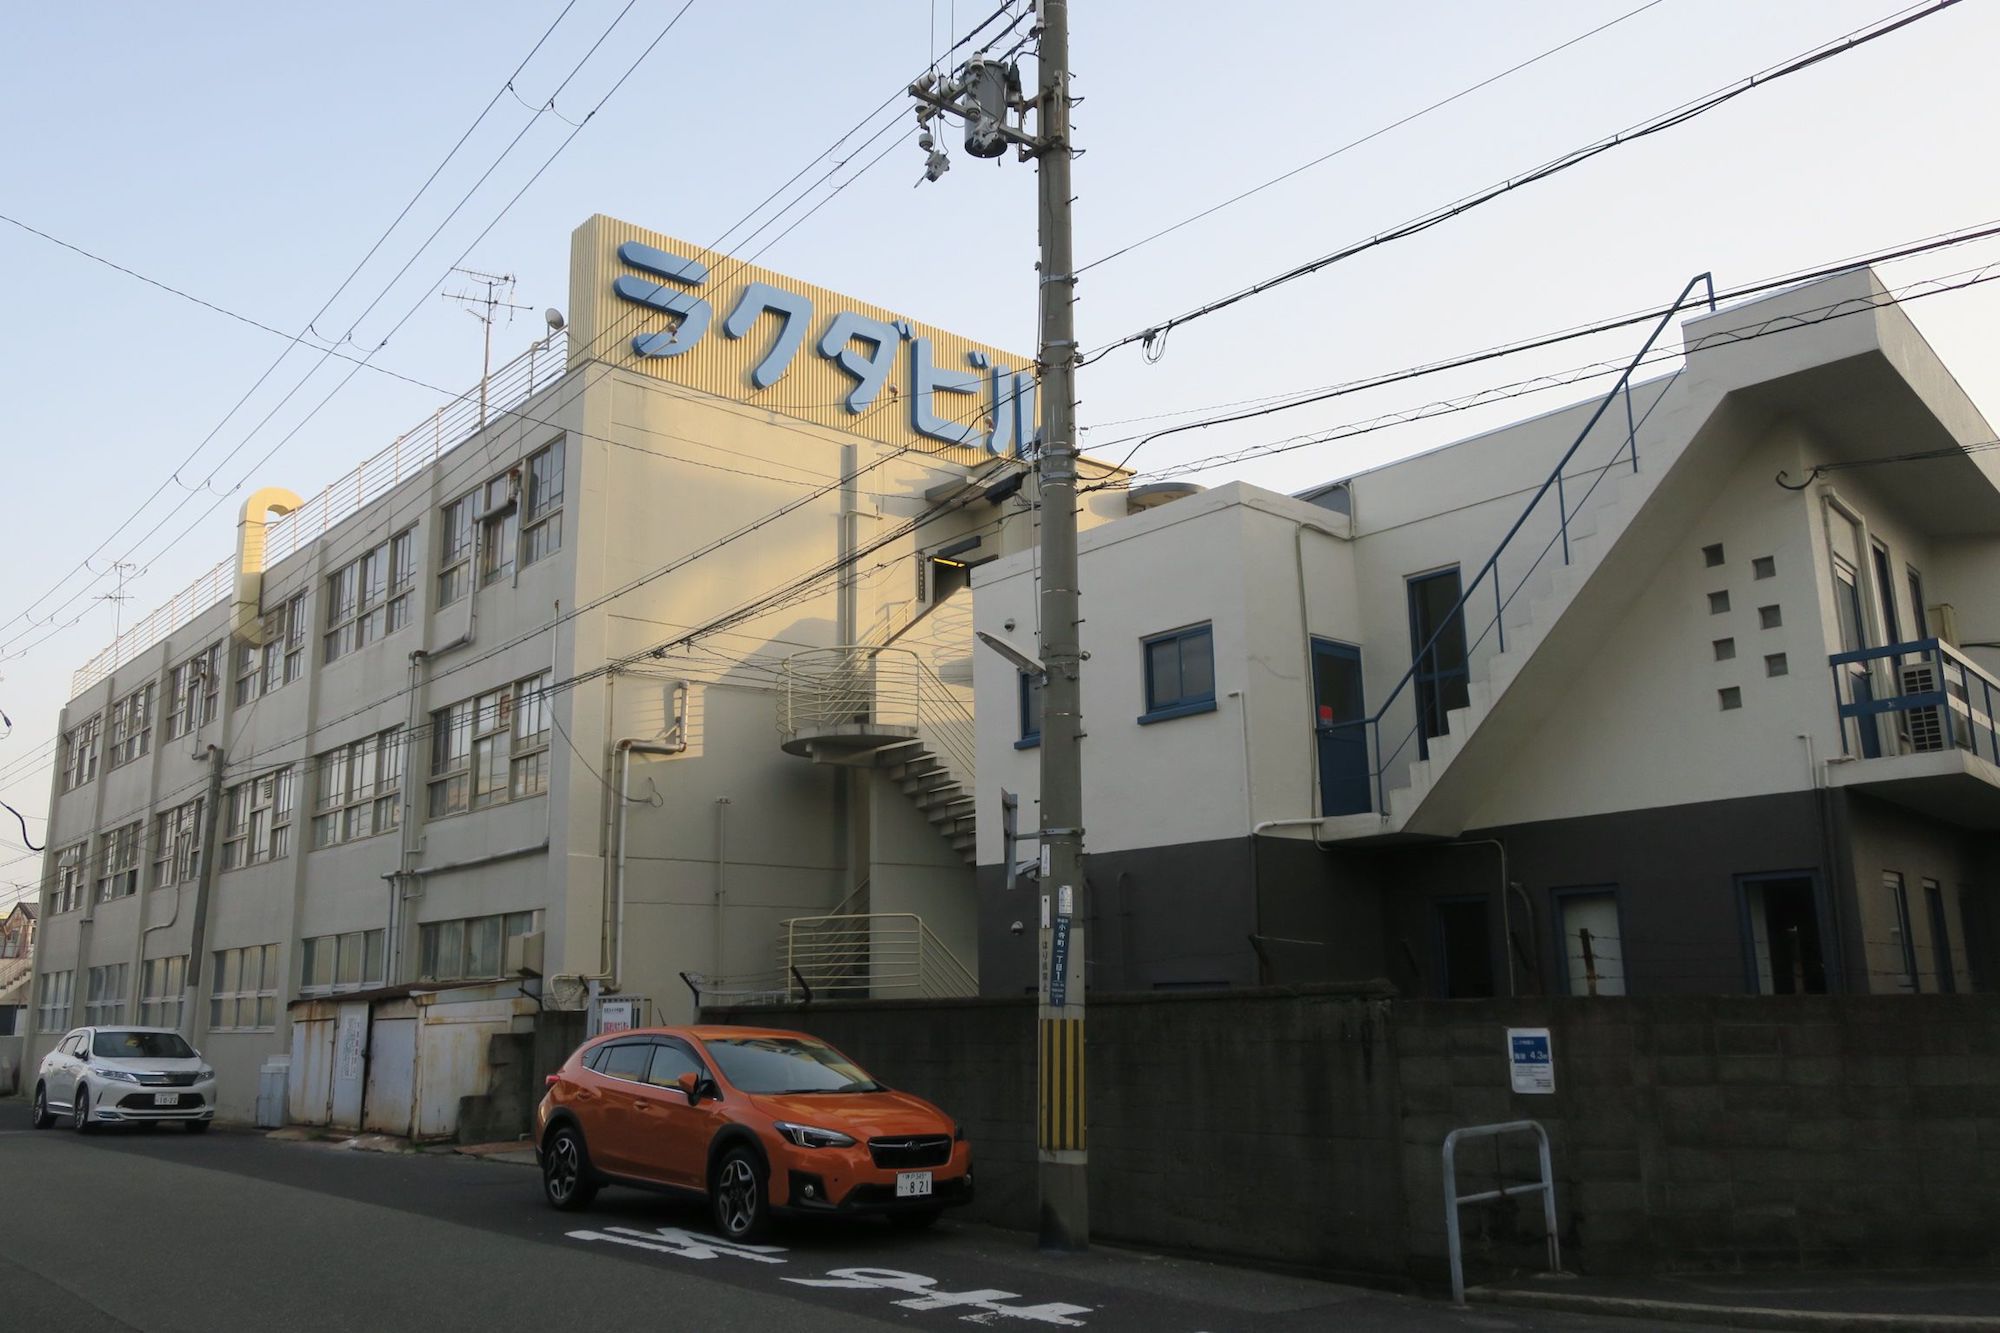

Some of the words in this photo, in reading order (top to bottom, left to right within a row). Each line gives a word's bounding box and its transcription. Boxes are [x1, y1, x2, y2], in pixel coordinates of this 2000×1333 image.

[614, 239, 1041, 459] ラクダビル
